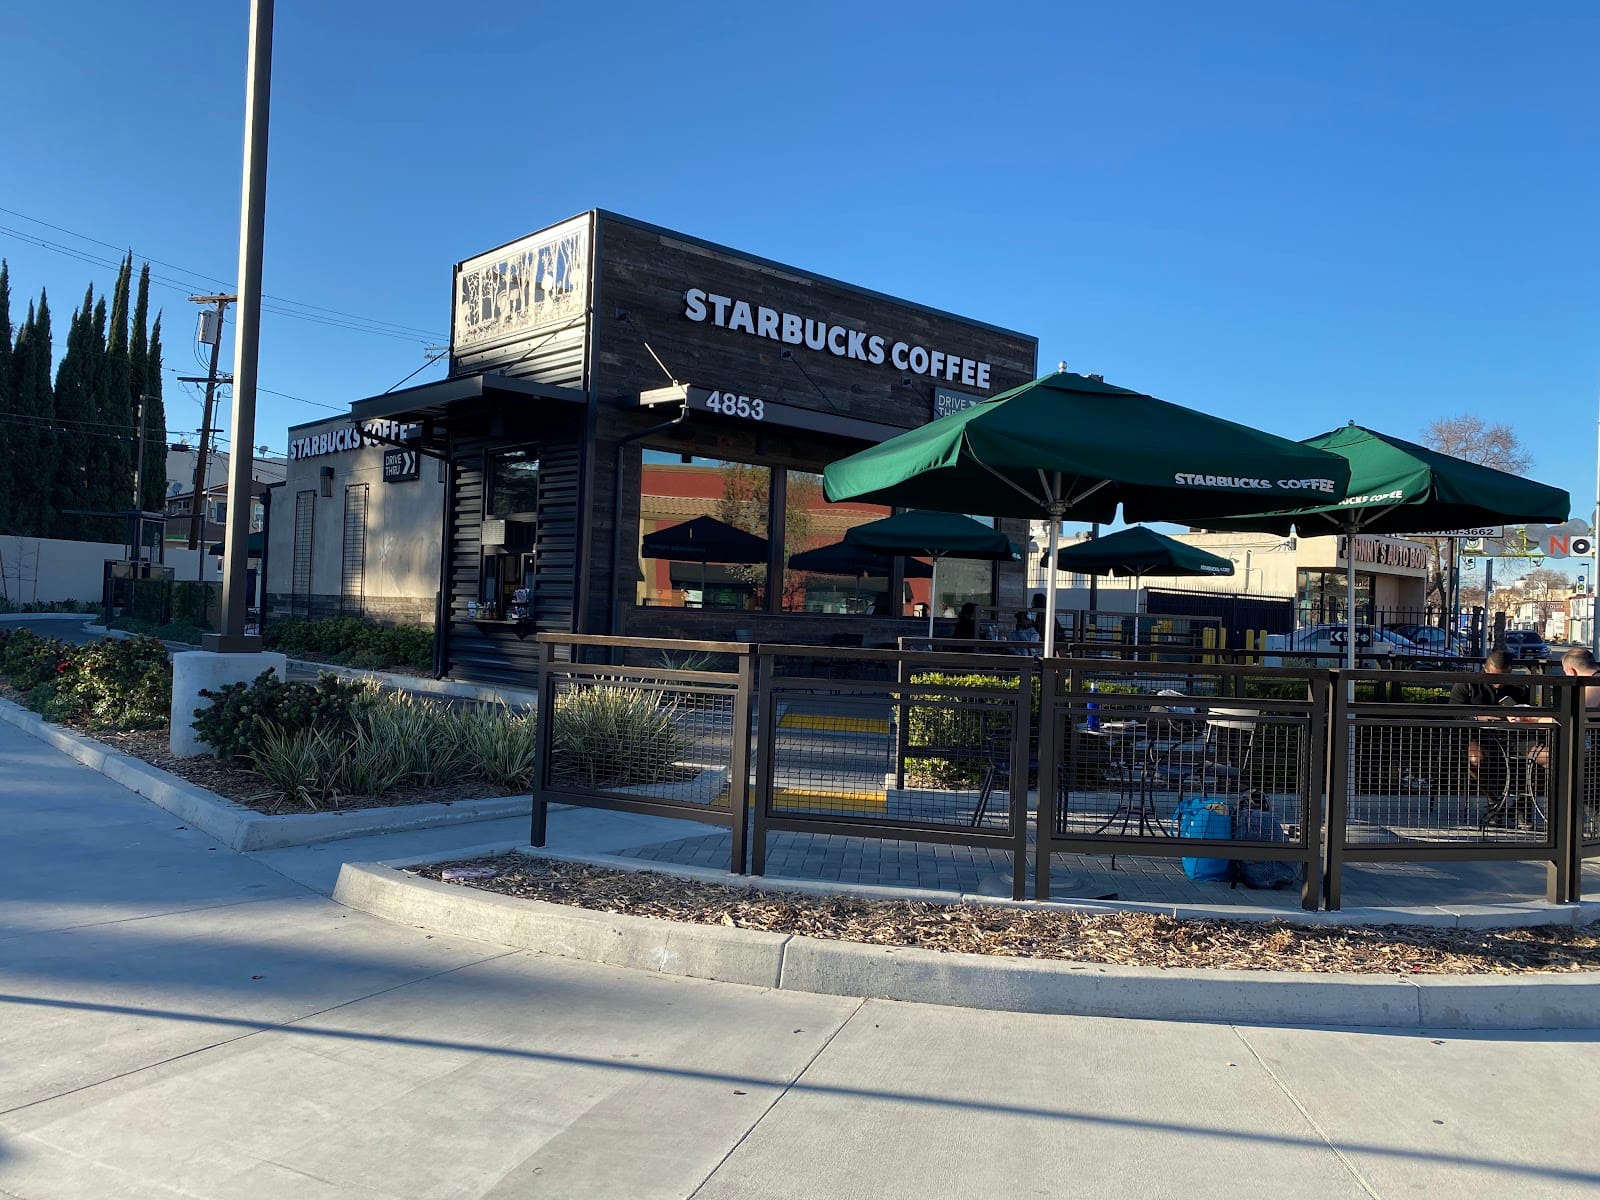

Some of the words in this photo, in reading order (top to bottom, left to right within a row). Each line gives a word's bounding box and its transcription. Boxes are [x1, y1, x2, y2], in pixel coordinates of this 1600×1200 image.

[684, 288, 885, 365] STARBUCKS
[891, 342, 991, 389] COFFEE
[706, 391, 765, 421] 4853
[938, 394, 966, 410] DRIVE
[938, 407, 959, 417] TH
[290, 428, 361, 460] STARBUCKS
[363, 420, 417, 446] COFFE
[385, 454, 402, 466] DRIVE
[385, 465, 401, 476] THRU
[1174, 472, 1272, 489] STARBUCKS
[1277, 478, 1335, 493] COFFEE
[1342, 537, 1387, 565] JHNNY'S
[1388, 544, 1410, 567] AUTO
